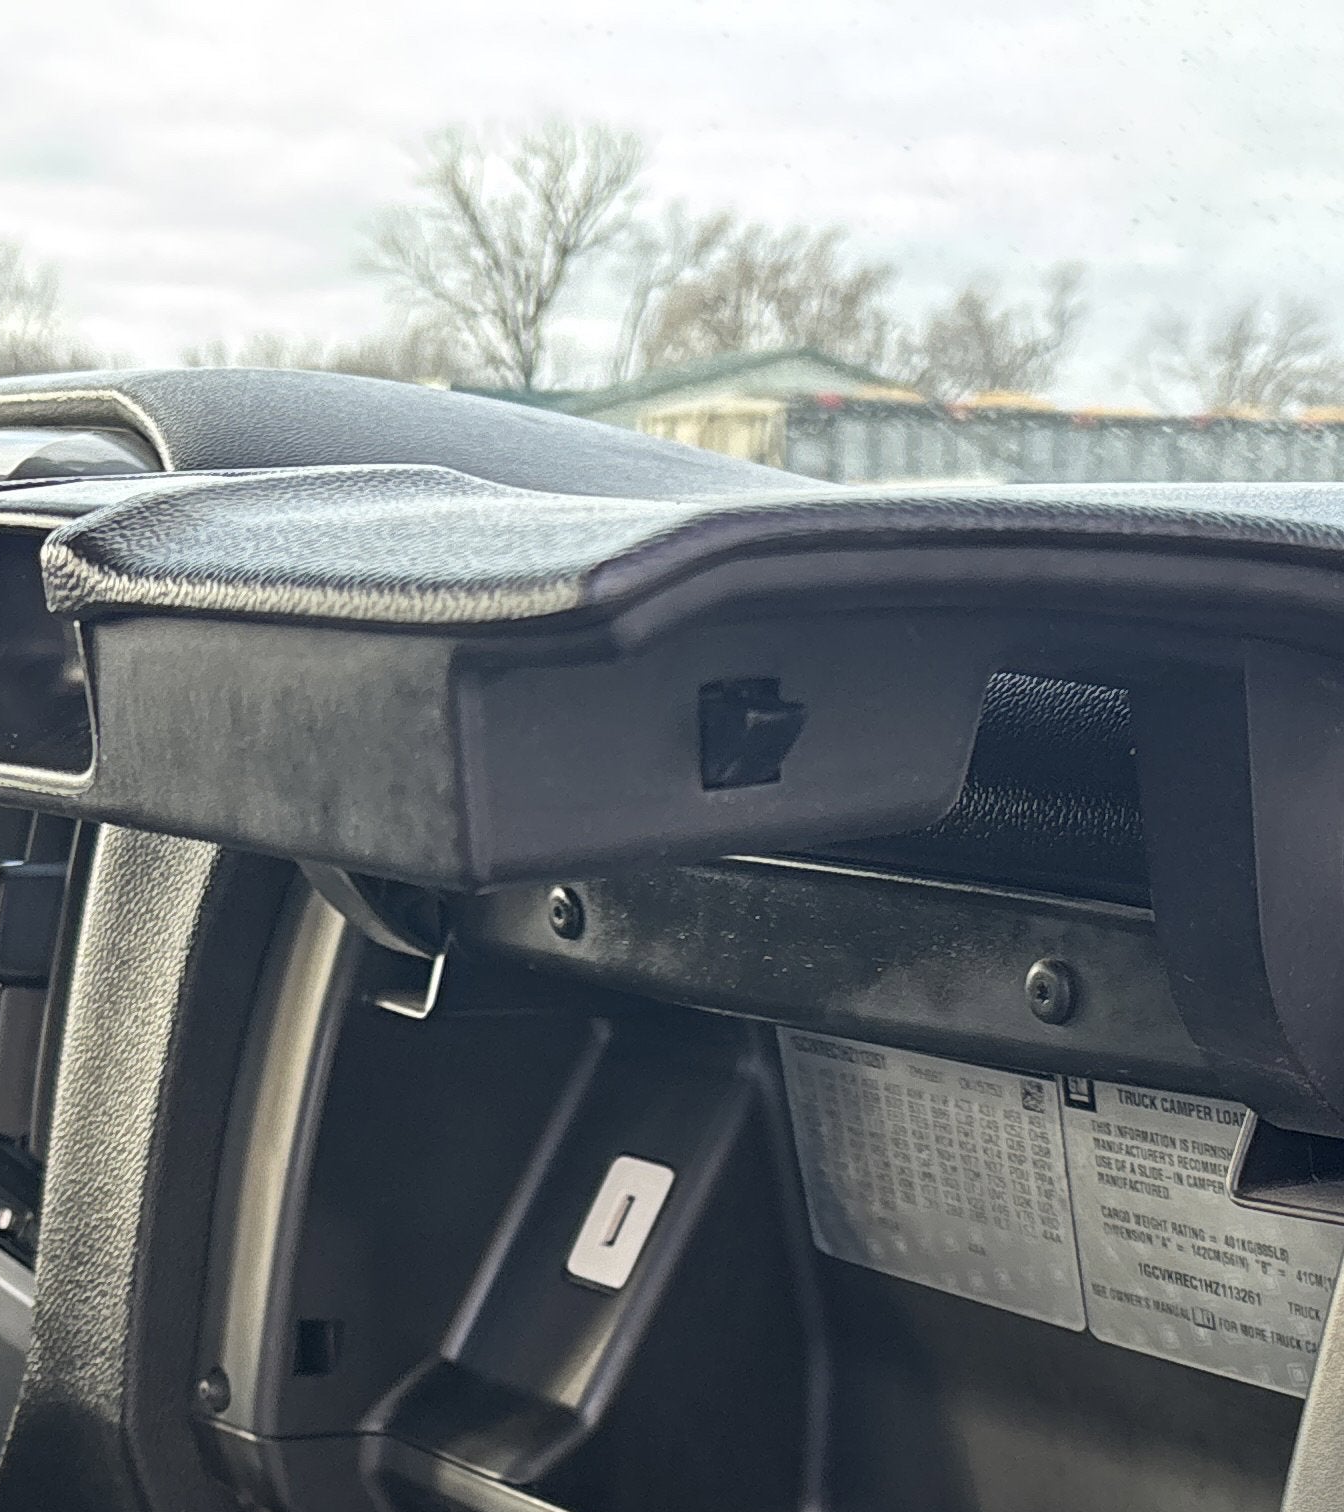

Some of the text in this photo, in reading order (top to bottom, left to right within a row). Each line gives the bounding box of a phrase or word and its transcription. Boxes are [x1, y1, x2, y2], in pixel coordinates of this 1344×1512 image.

[1117, 1089, 1157, 1111] TRUCK
[1160, 1098, 1213, 1122] CAMPER
[1091, 1119, 1112, 1136] THIS
[1114, 1124, 1176, 1149] INFORMATION
[1179, 1138, 1189, 1153] IS
[1096, 1154, 1113, 1171] USE
[1186, 1174, 1225, 1195] CAMPER
[1101, 1205, 1130, 1223] CARGO
[1132, 1211, 1167, 1232] WEIGHT
[1170, 1221, 1205, 1242] RATING
[1138, 1262, 1321, 1322] 1GCVKREC1HZ113261 TRUCK
[1152, 1299, 1191, 1321] MANUAL
[1218, 1316, 1238, 1334] FOR
[1270, 1330, 1302, 1352] TRUCK
